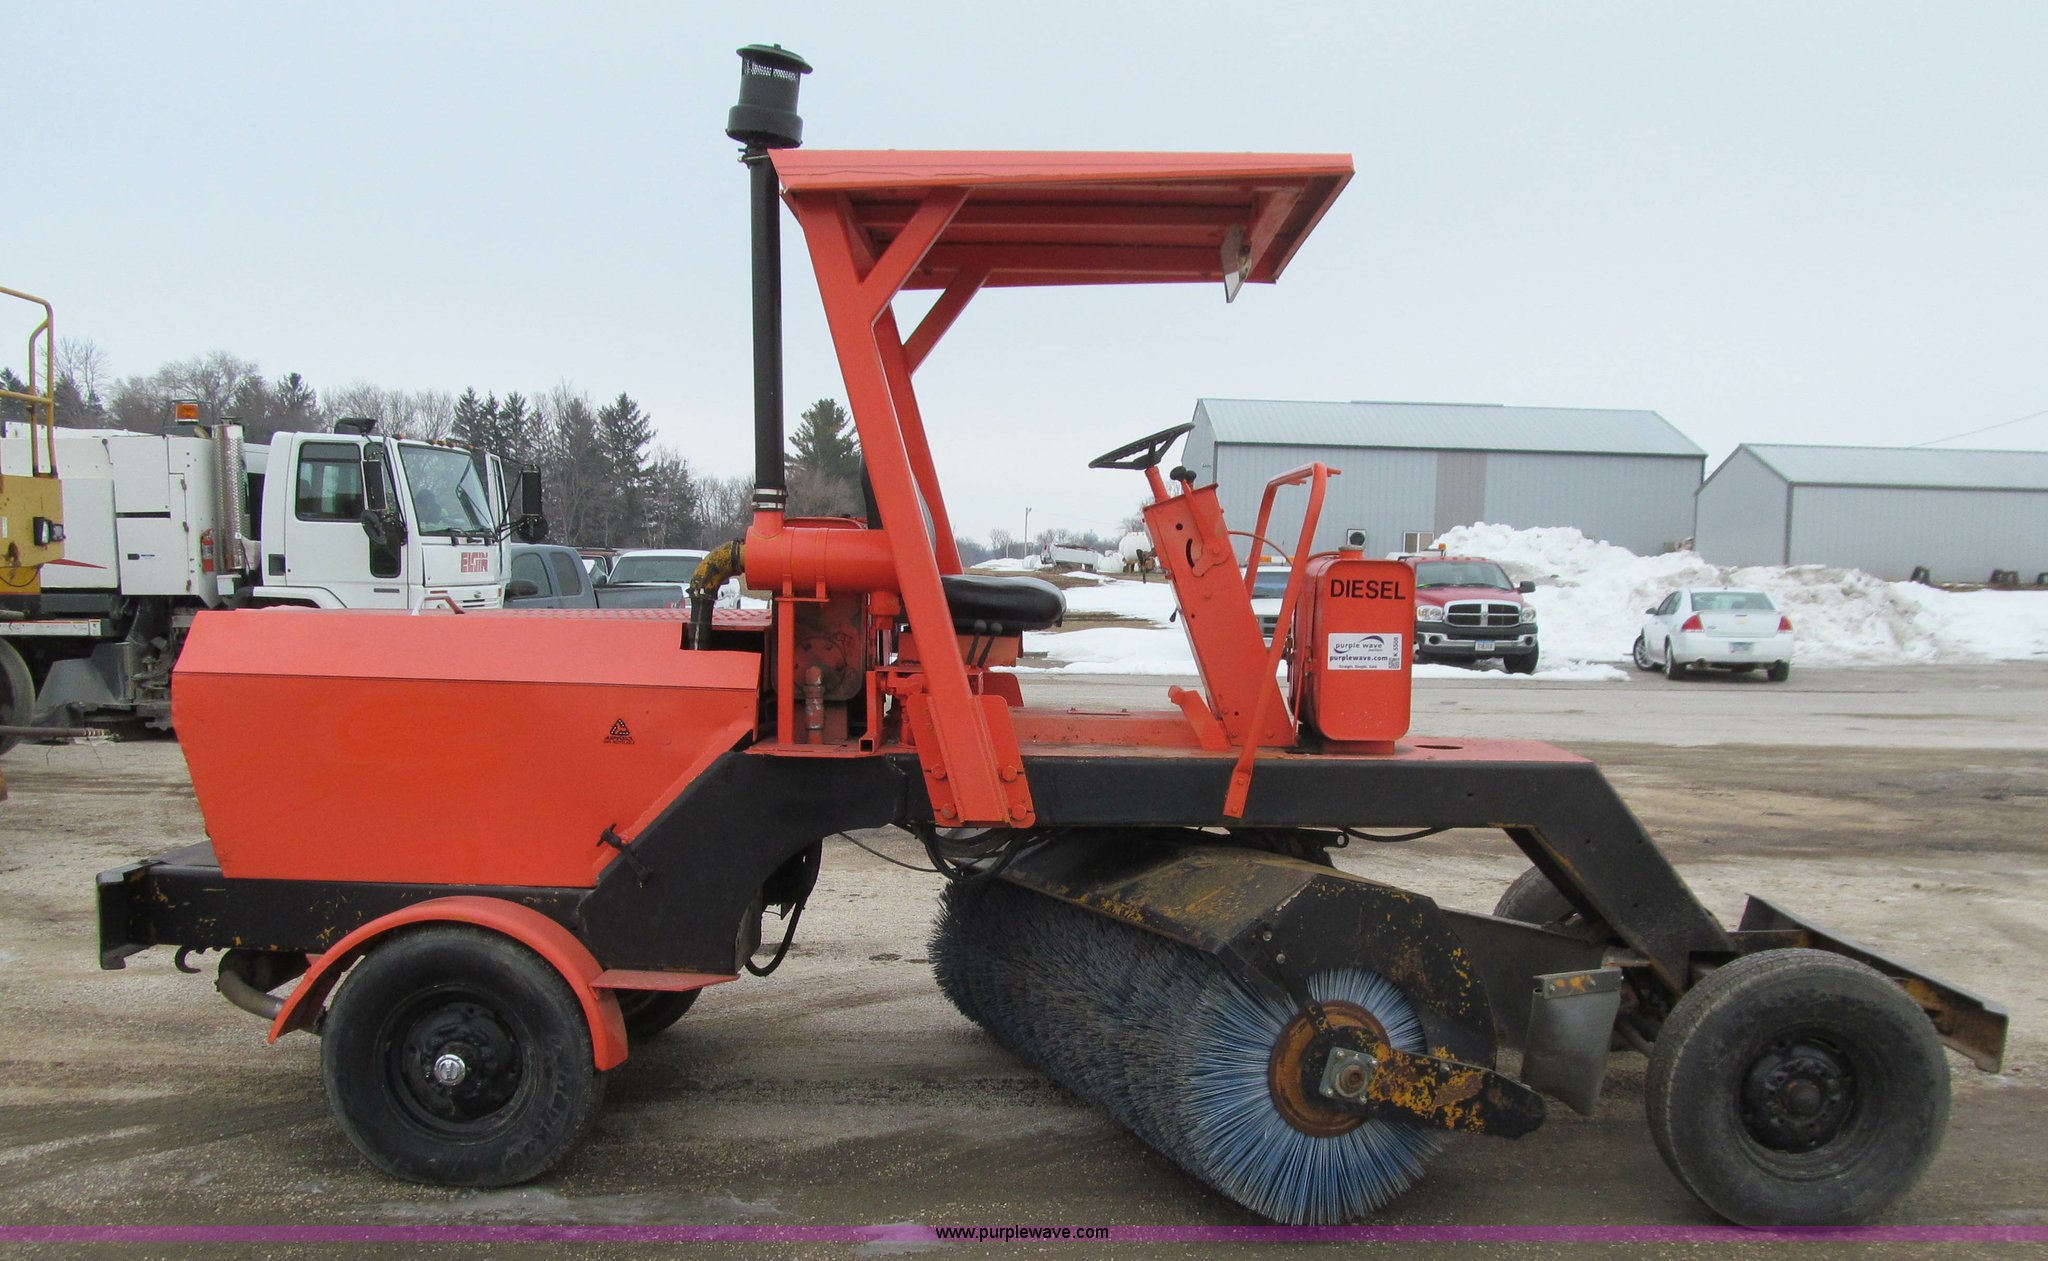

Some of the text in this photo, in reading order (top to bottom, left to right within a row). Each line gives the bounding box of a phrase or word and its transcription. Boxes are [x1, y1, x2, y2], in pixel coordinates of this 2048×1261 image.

[461, 552, 488, 573] ELGIN
[1330, 579, 1406, 600] DIESEL
[1335, 642, 1360, 651] purple
[1329, 654, 1388, 662] purplewave.com
